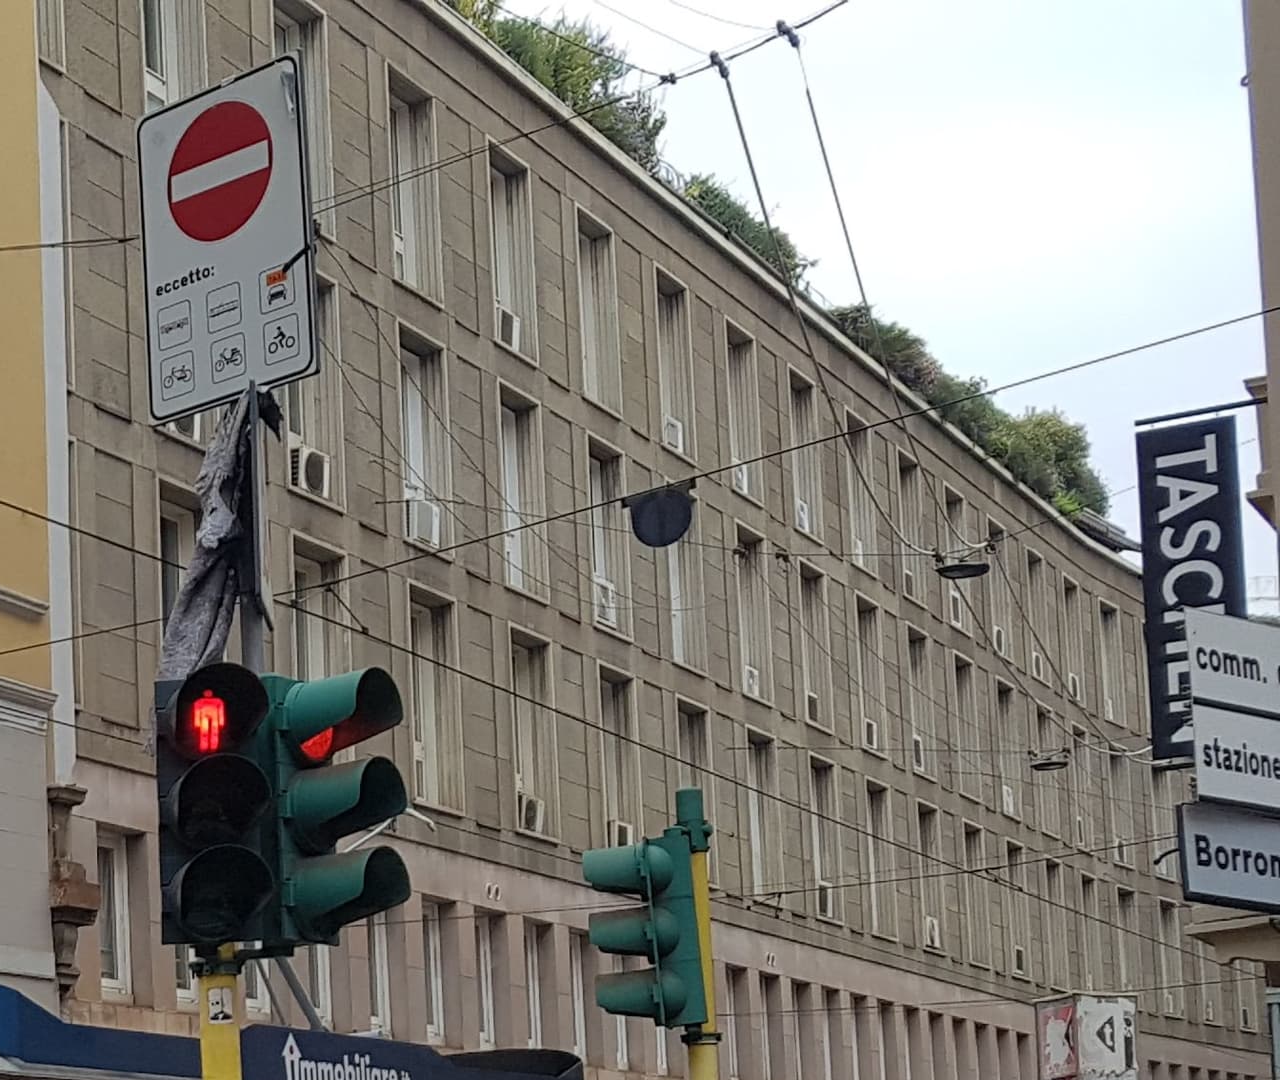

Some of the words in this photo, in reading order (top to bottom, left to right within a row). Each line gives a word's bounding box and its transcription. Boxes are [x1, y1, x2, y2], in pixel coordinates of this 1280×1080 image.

[155, 265, 215, 296] eccetto:
[1196, 646, 1268, 684] comm.
[1203, 737, 1280, 780] stazione
